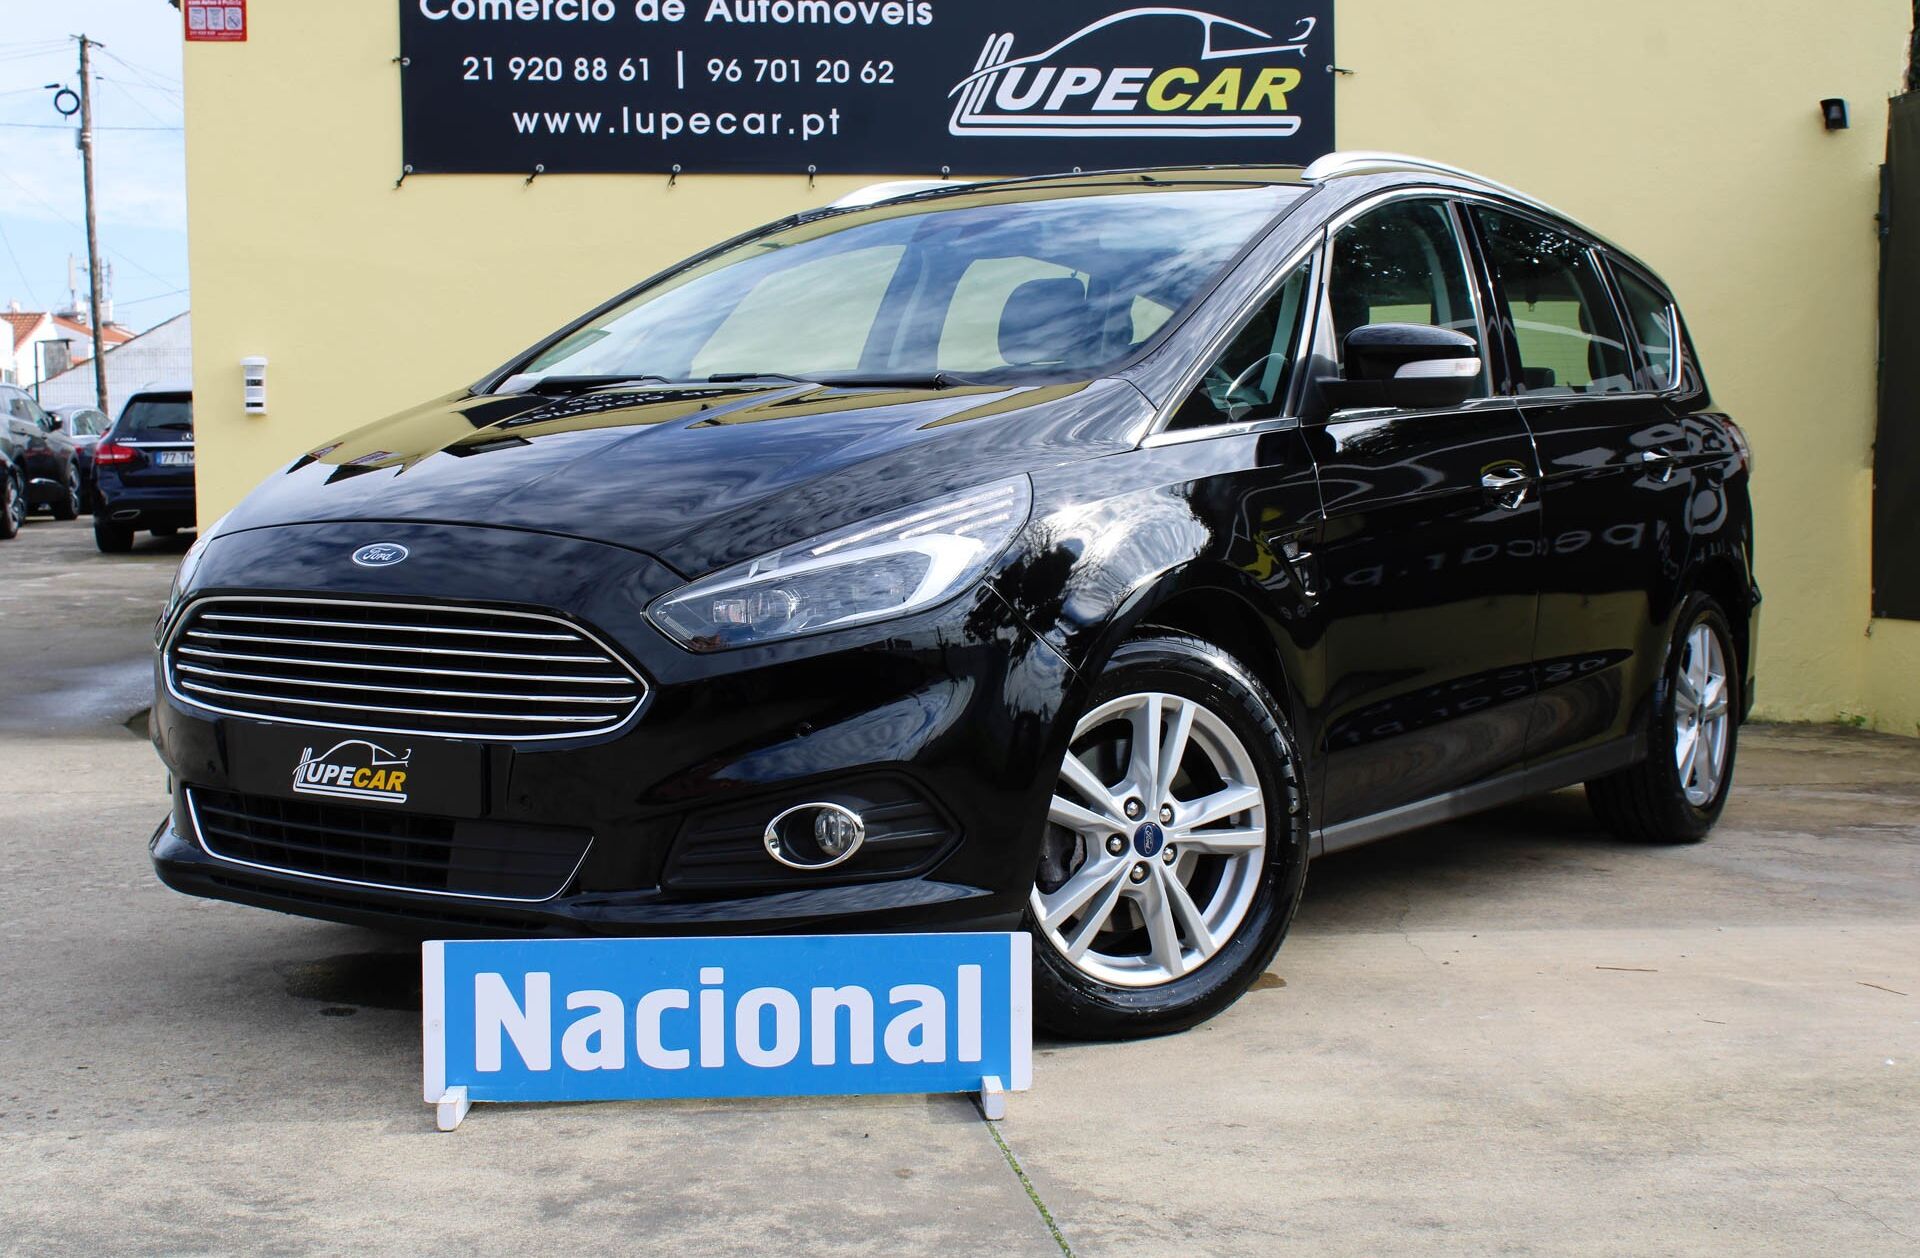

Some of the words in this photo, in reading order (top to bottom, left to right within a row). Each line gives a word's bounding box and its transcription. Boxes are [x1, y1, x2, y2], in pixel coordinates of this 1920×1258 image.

[634, 0, 686, 22] de
[462, 56, 493, 81] 21
[508, 56, 563, 82] 920
[573, 57, 608, 82] 88
[618, 57, 649, 82] 61
[707, 58, 743, 83] 96
[753, 58, 800, 83] 701
[815, 59, 850, 84] 20
[859, 60, 895, 84] 62
[512, 106, 840, 141] www.lupecar.pt
[362, 547, 397, 561] Ford
[475, 964, 982, 1072] Nacional
